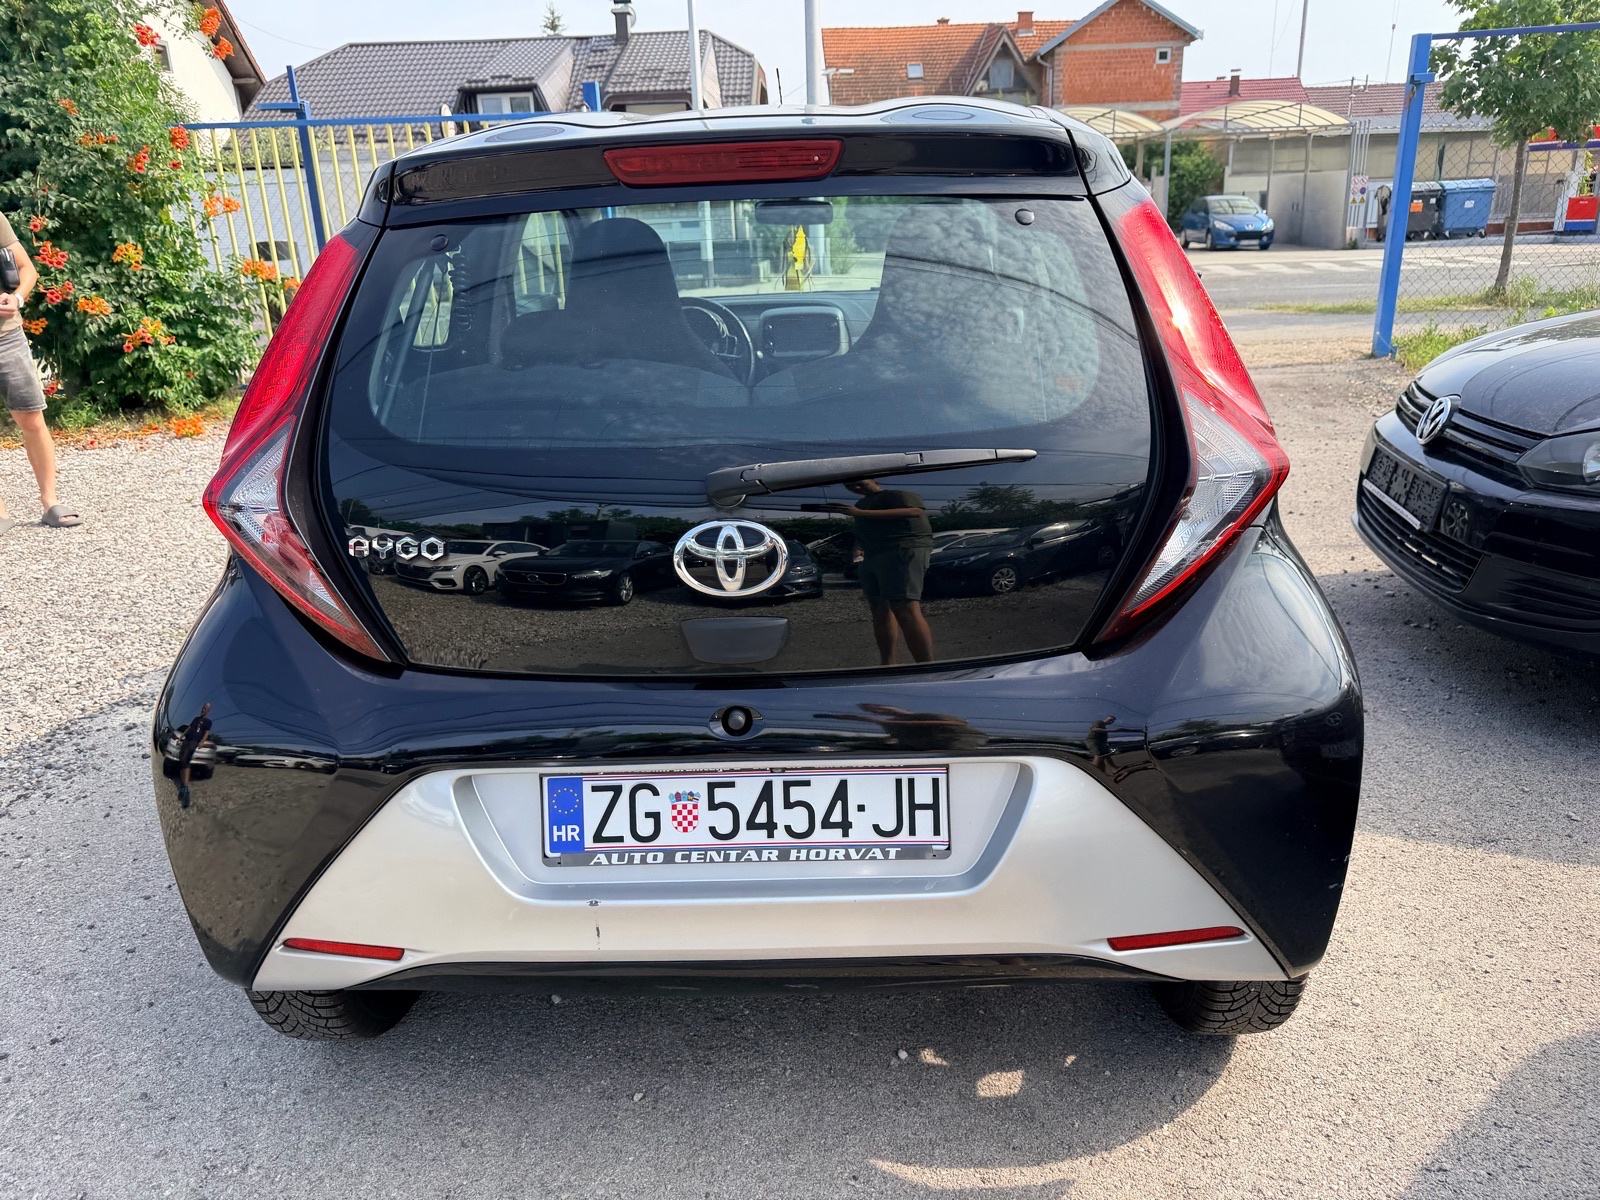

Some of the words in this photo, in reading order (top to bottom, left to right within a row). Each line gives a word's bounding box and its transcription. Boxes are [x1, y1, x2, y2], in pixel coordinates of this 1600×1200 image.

[348, 535, 445, 561] AYGO
[591, 782, 662, 844] ZG
[552, 825, 581, 843] HR
[589, 851, 664, 866] AUTO
[674, 848, 780, 864] CENTAR
[789, 847, 902, 862] HORVAT
